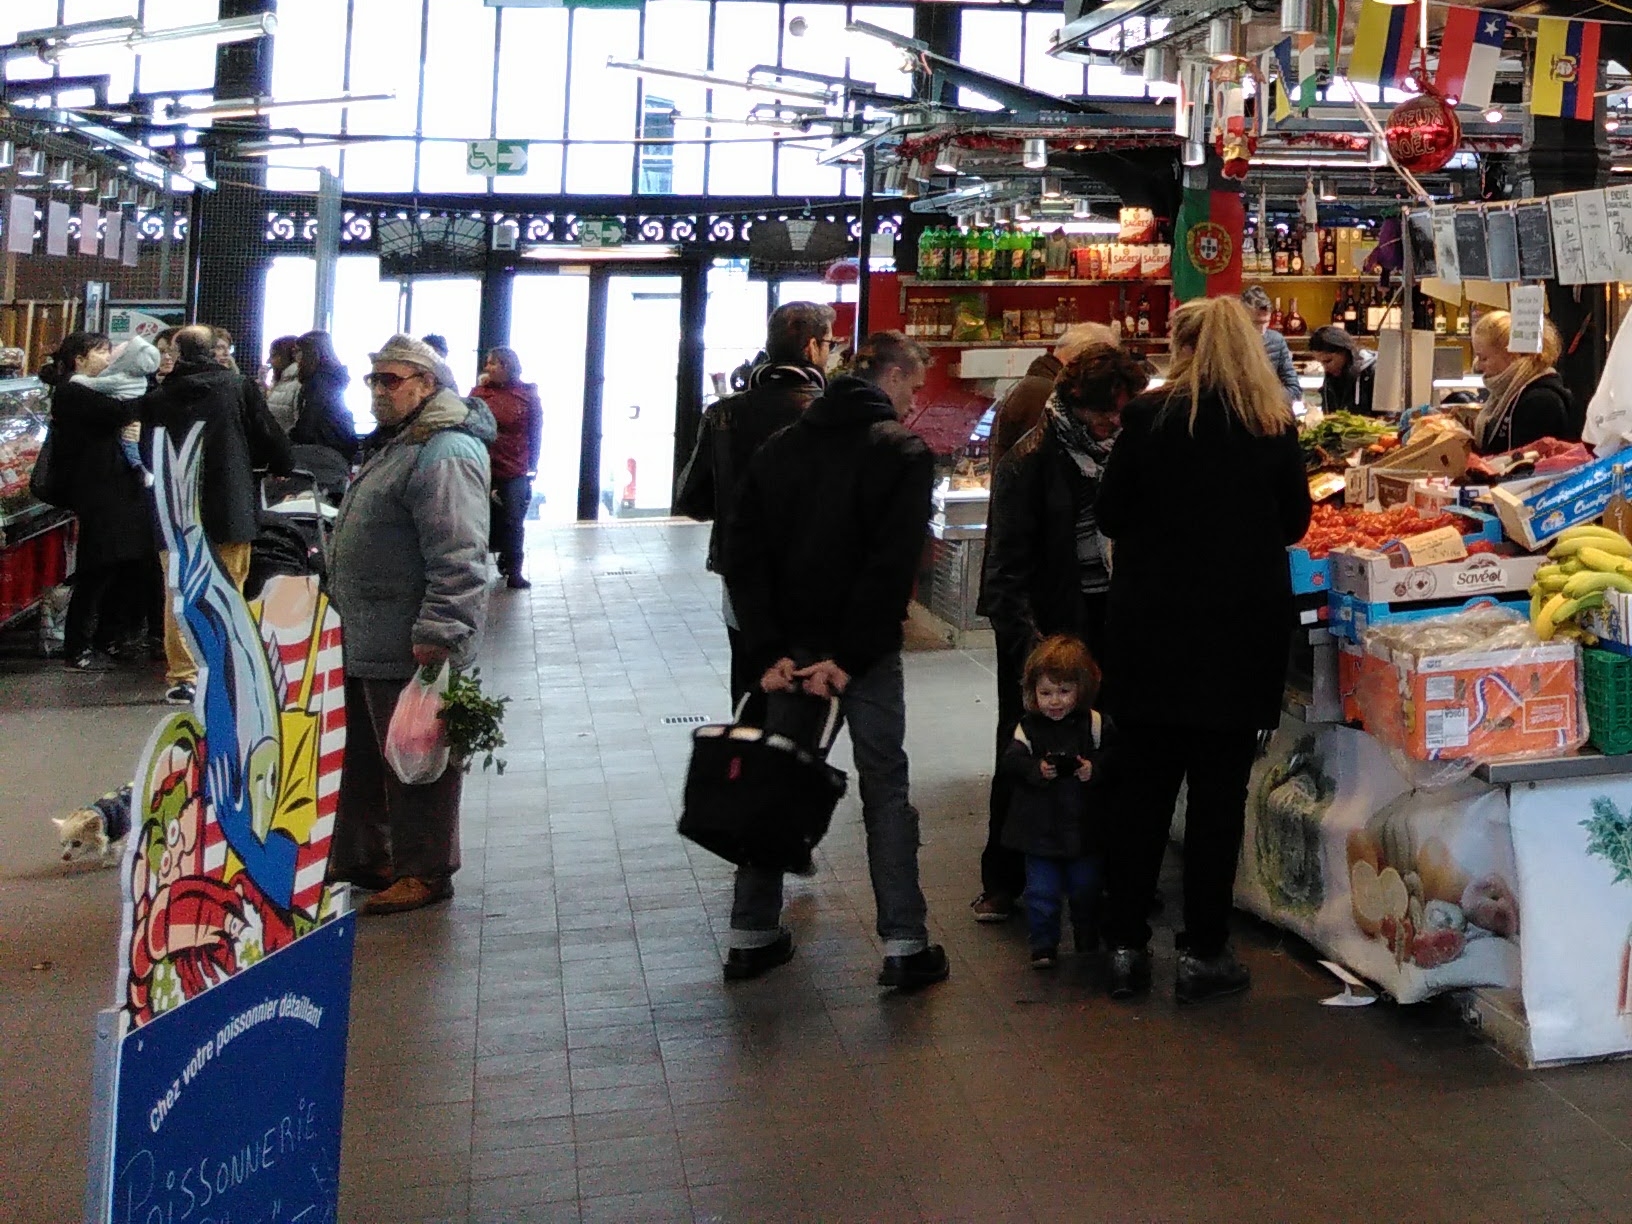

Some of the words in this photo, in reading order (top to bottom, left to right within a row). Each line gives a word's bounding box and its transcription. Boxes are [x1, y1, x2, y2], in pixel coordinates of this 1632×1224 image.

[1457, 569, 1502, 585] Savéol
[150, 1077, 182, 1133] Chez
[183, 1041, 214, 1085] votre
[216, 997, 279, 1056] poissonnier
[279, 992, 324, 1028] détaillant
